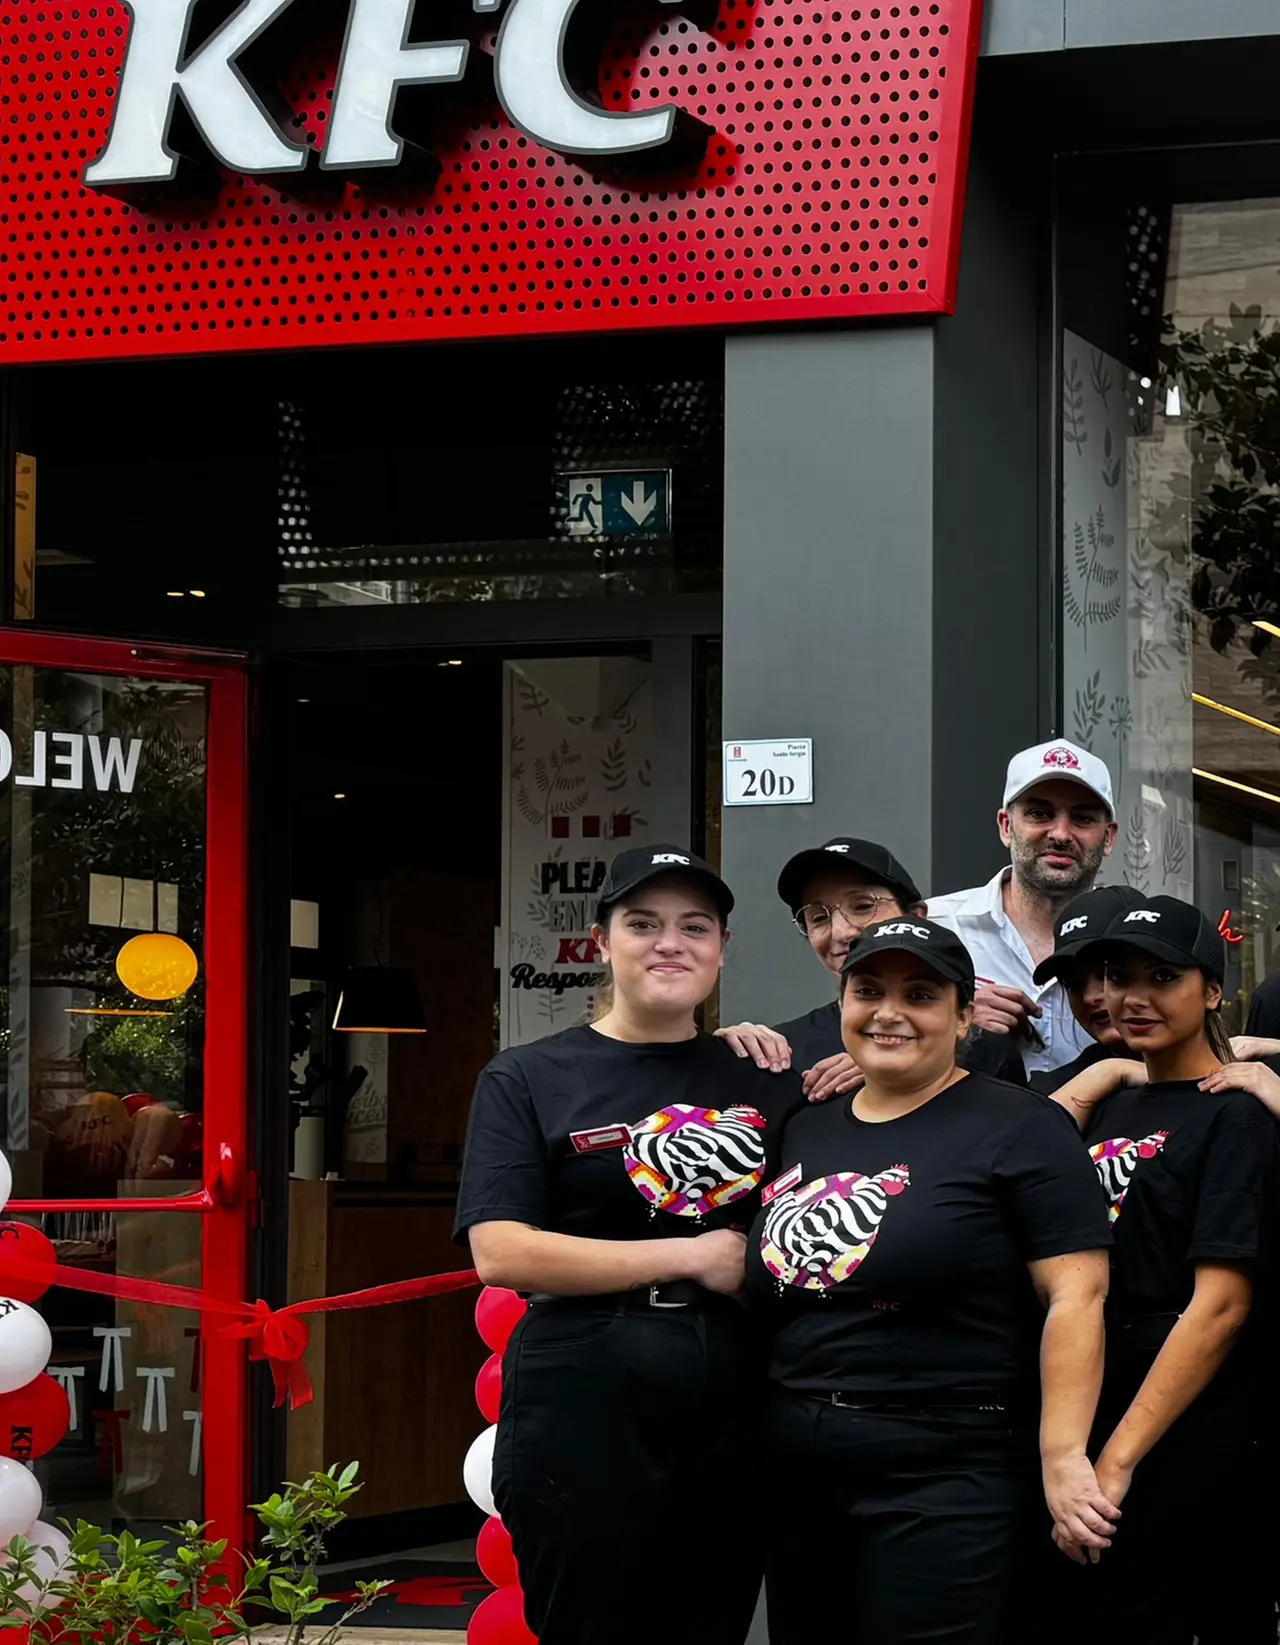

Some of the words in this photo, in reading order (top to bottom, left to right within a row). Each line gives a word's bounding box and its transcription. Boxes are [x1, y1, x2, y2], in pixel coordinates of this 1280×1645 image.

[81, 0, 686, 186] KFC
[741, 768, 795, 797] 20D
[651, 853, 690, 865] KFC
[1123, 910, 1161, 923] KFC
[873, 922, 930, 939] KFC
[1060, 915, 1088, 937] KFC
[872, 1298, 902, 1311] KFC
